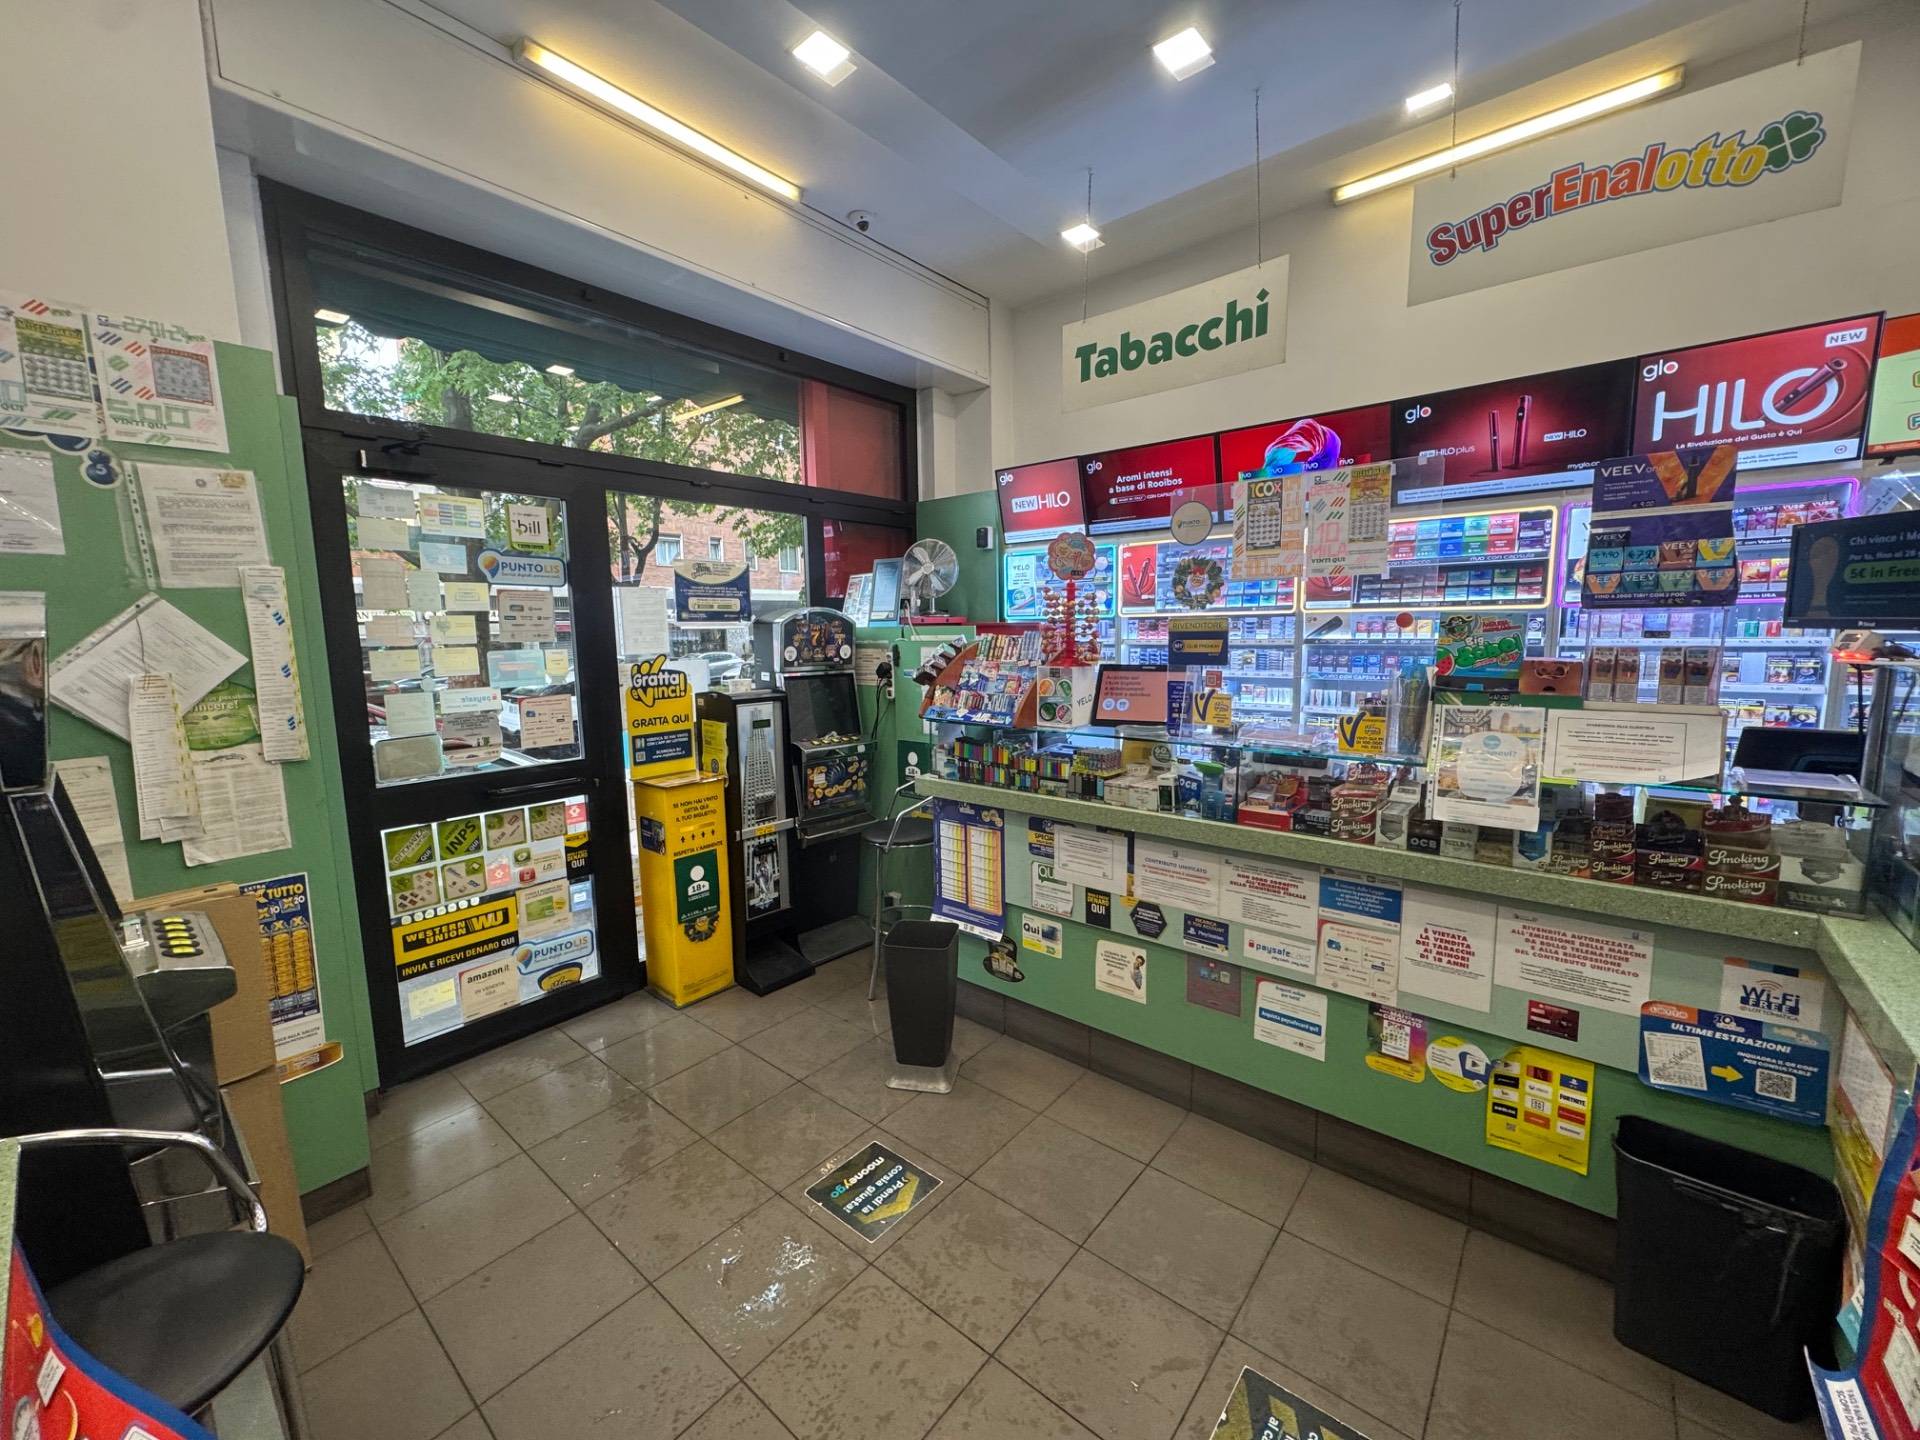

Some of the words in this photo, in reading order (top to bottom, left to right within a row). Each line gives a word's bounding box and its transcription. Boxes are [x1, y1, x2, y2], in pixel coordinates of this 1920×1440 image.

[1426, 130, 1770, 266] SuperEnalotto
[1075, 287, 1270, 383] Tabacchi
[1829, 330, 1864, 345] NEW
[1643, 359, 1679, 382] glo
[1651, 367, 1840, 442] HILO
[1405, 404, 1432, 423] glo
[1545, 433, 1563, 442] NEW
[1563, 428, 1587, 440] HILO
[1686, 436, 1734, 448] Rivoluzione
[1734, 433, 1749, 443] del
[1750, 432, 1777, 442] Gusto
[1786, 428, 1803, 437] Qui
[1086, 459, 1103, 475] glo
[1601, 463, 1646, 477] VEEV
[999, 473, 1013, 486] glo
[1116, 473, 1141, 484] Aromi
[1143, 467, 1173, 479] intensi
[1115, 483, 1136, 493] base
[1137, 480, 1146, 491] di
[1147, 476, 1183, 489] Rooibos
[1014, 498, 1036, 510] NEW
[1038, 491, 1071, 510] HILO
[517, 520, 541, 534] bill
[1663, 542, 1696, 551] VEEV
[1850, 536, 1866, 546] Chi
[501, 562, 560, 574] PUNTOLIS
[1871, 566, 1884, 578] in
[1624, 573, 1657, 582] VEEV
[633, 672, 680, 688] Gratta
[1076, 694, 1093, 708] VELO
[632, 716, 669, 729] GRATTA
[672, 713, 690, 724] QUI
[1178, 779, 1197, 791] OCB
[680, 800, 693, 808] NON
[703, 795, 719, 803] VINTO
[1331, 798, 1372, 814] Smoking
[1331, 819, 1372, 834] Smoking
[445, 821, 476, 855] INPS
[1410, 837, 1437, 849] OCB
[1593, 840, 1633, 853] Smoking
[571, 859, 586, 868] QUI
[1552, 854, 1589, 869] Smoking
[1649, 854, 1689, 867] Smoking
[1708, 850, 1769, 868] Smoking
[1592, 861, 1632, 875] Smoking
[692, 883, 706, 893] 18+
[1706, 872, 1766, 892] Smoking
[267, 883, 304, 899] TUTTO
[294, 894, 305, 904] 20
[1283, 891, 1306, 900] FISCALE
[270, 905, 280, 915] 10
[1091, 904, 1106, 915] QUI
[471, 910, 504, 932] WU
[1023, 923, 1040, 935] Qui
[406, 921, 466, 943] WESTERN
[426, 929, 466, 946] UNION
[1432, 930, 1468, 942] VIETATA
[1522, 924, 1567, 938] RIVENDITA
[1571, 933, 1635, 950] AUTORIZZATA
[534, 936, 588, 959] PUNTOLIS
[1416, 939, 1429, 947] DEI
[1432, 943, 1475, 957] TABACCHI
[1433, 937, 1471, 949] VENDITA
[1511, 929, 1576, 946] ALL'EMISSIONE
[1579, 941, 1605, 951] DELLE
[1608, 945, 1647, 960] MARCHE
[1525, 937, 1537, 945] DA
[1540, 941, 1568, 951] BOLLO
[1571, 947, 1630, 963] TELEMATICHE
[403, 962, 427, 977] INVIA
[429, 960, 436, 969] E
[437, 952, 464, 967] RICEVI
[466, 941, 499, 959] DENARO
[501, 936, 515, 948] QUI
[1436, 950, 1470, 962] MINORI
[1446, 959, 1469, 969] ANNI
[1515, 948, 1529, 956] DEL
[1532, 952, 1587, 968] CONTRIBUTO
[1590, 963, 1640, 978] UNIFICATO
[1539, 947, 1559, 956] ALLA
[1562, 951, 1622, 968] RISCOSSIONE
[467, 964, 510, 984] amazon.it
[1741, 984, 1801, 1009] Wi-Fi
[1748, 998, 1790, 1014] FREE
[1383, 1013, 1421, 1028] COLORATO
[1671, 1022, 1713, 1038] ULTIME
[1715, 1030, 1792, 1054] ESTRAZIONI
[1737, 1051, 1776, 1063] INQUADRA
[1797, 1063, 1819, 1072] CODE
[1757, 1061, 1812, 1076] CONSULTARLE
[830, 1156, 885, 1199] mooneygo
[874, 1164, 903, 1187] corsia
[843, 1184, 876, 1214] giusta!
[871, 1180, 904, 1208] Prendi
[861, 1204, 875, 1215] la
